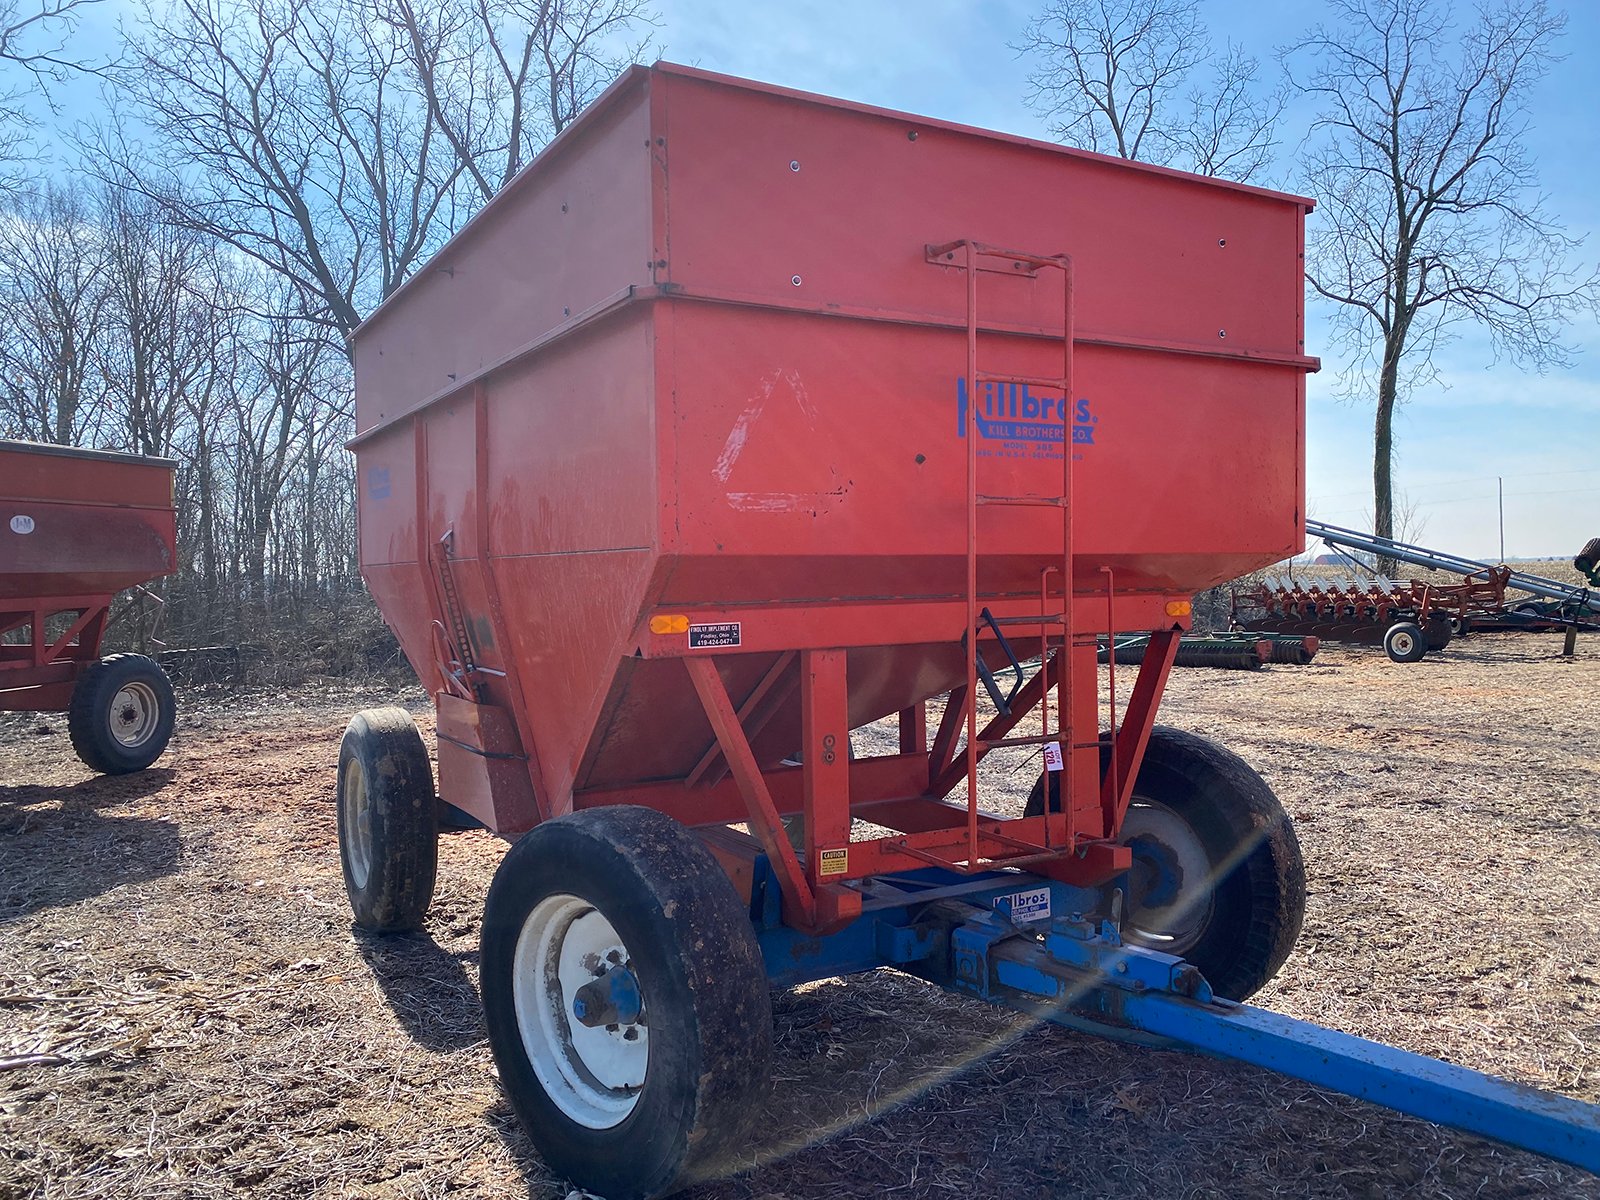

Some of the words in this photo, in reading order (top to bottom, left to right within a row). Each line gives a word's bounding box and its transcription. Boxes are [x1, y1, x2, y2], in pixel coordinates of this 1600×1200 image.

[988, 425, 1010, 436] KILL
[1015, 426, 1065, 439] BROTHERS
[697, 638, 733, 646] 419-424-0471
[1045, 750, 1056, 765] 120
